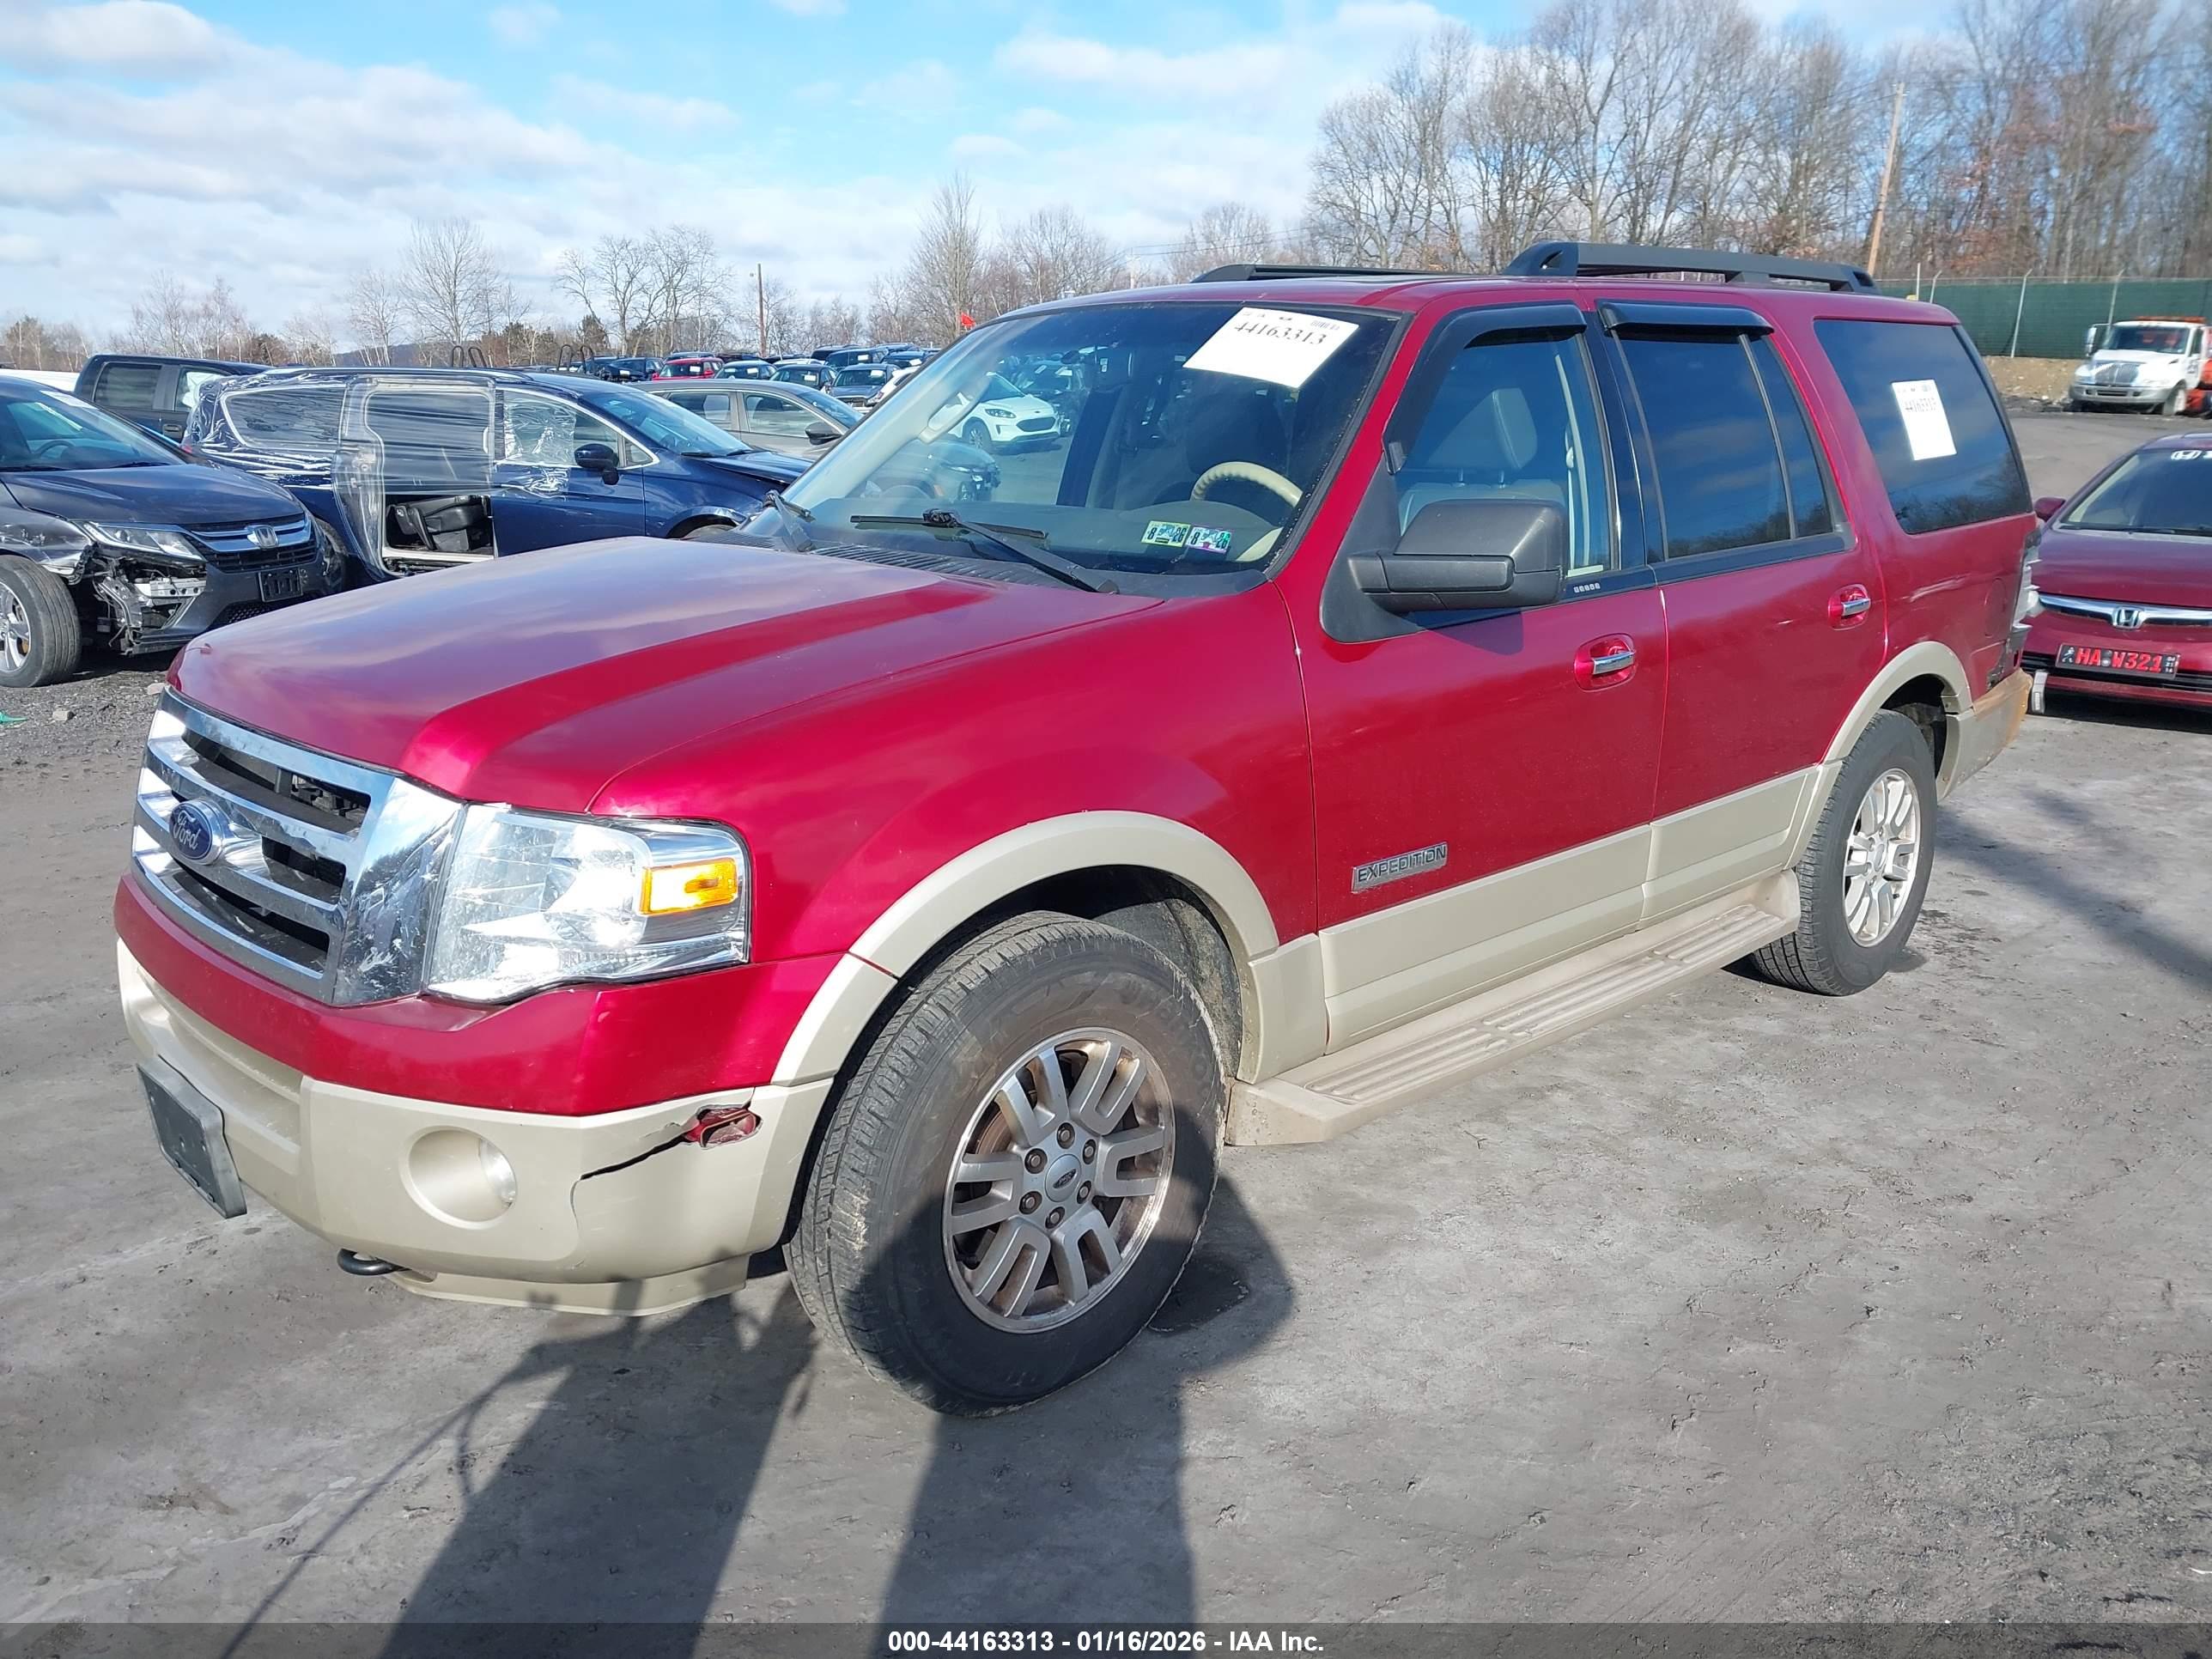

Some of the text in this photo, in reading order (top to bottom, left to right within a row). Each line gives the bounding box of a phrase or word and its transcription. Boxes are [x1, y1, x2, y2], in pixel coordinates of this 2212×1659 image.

[1234, 321, 1327, 345] 44163313
[2075, 647, 2162, 673] HA W321
[173, 810, 201, 850] Ford
[1358, 844, 1446, 883] EXPEDITION
